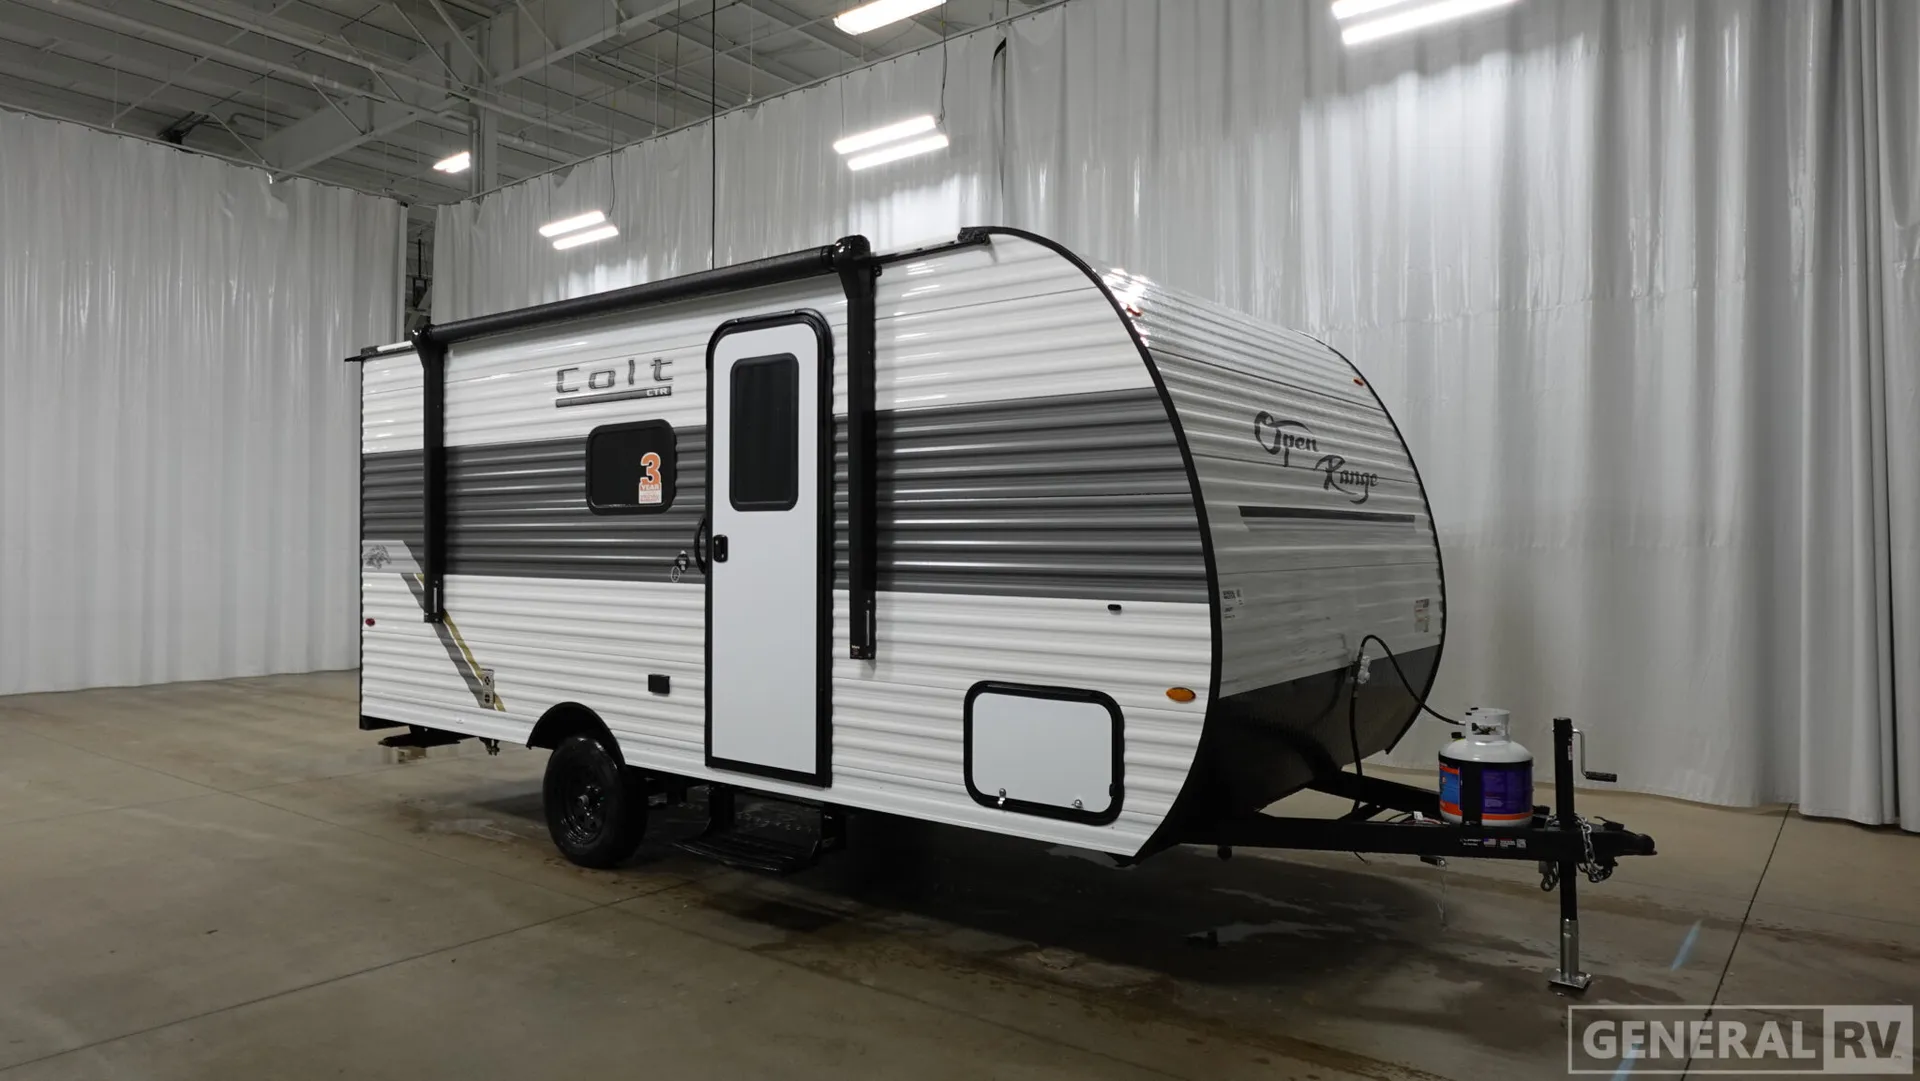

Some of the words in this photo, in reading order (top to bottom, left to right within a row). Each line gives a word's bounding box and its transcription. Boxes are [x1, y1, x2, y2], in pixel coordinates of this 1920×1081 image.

[556, 359, 673, 393] Colt
[646, 388, 668, 397] CTR
[1254, 410, 1319, 467] Open
[640, 452, 661, 486] 3
[1315, 454, 1379, 504] Range
